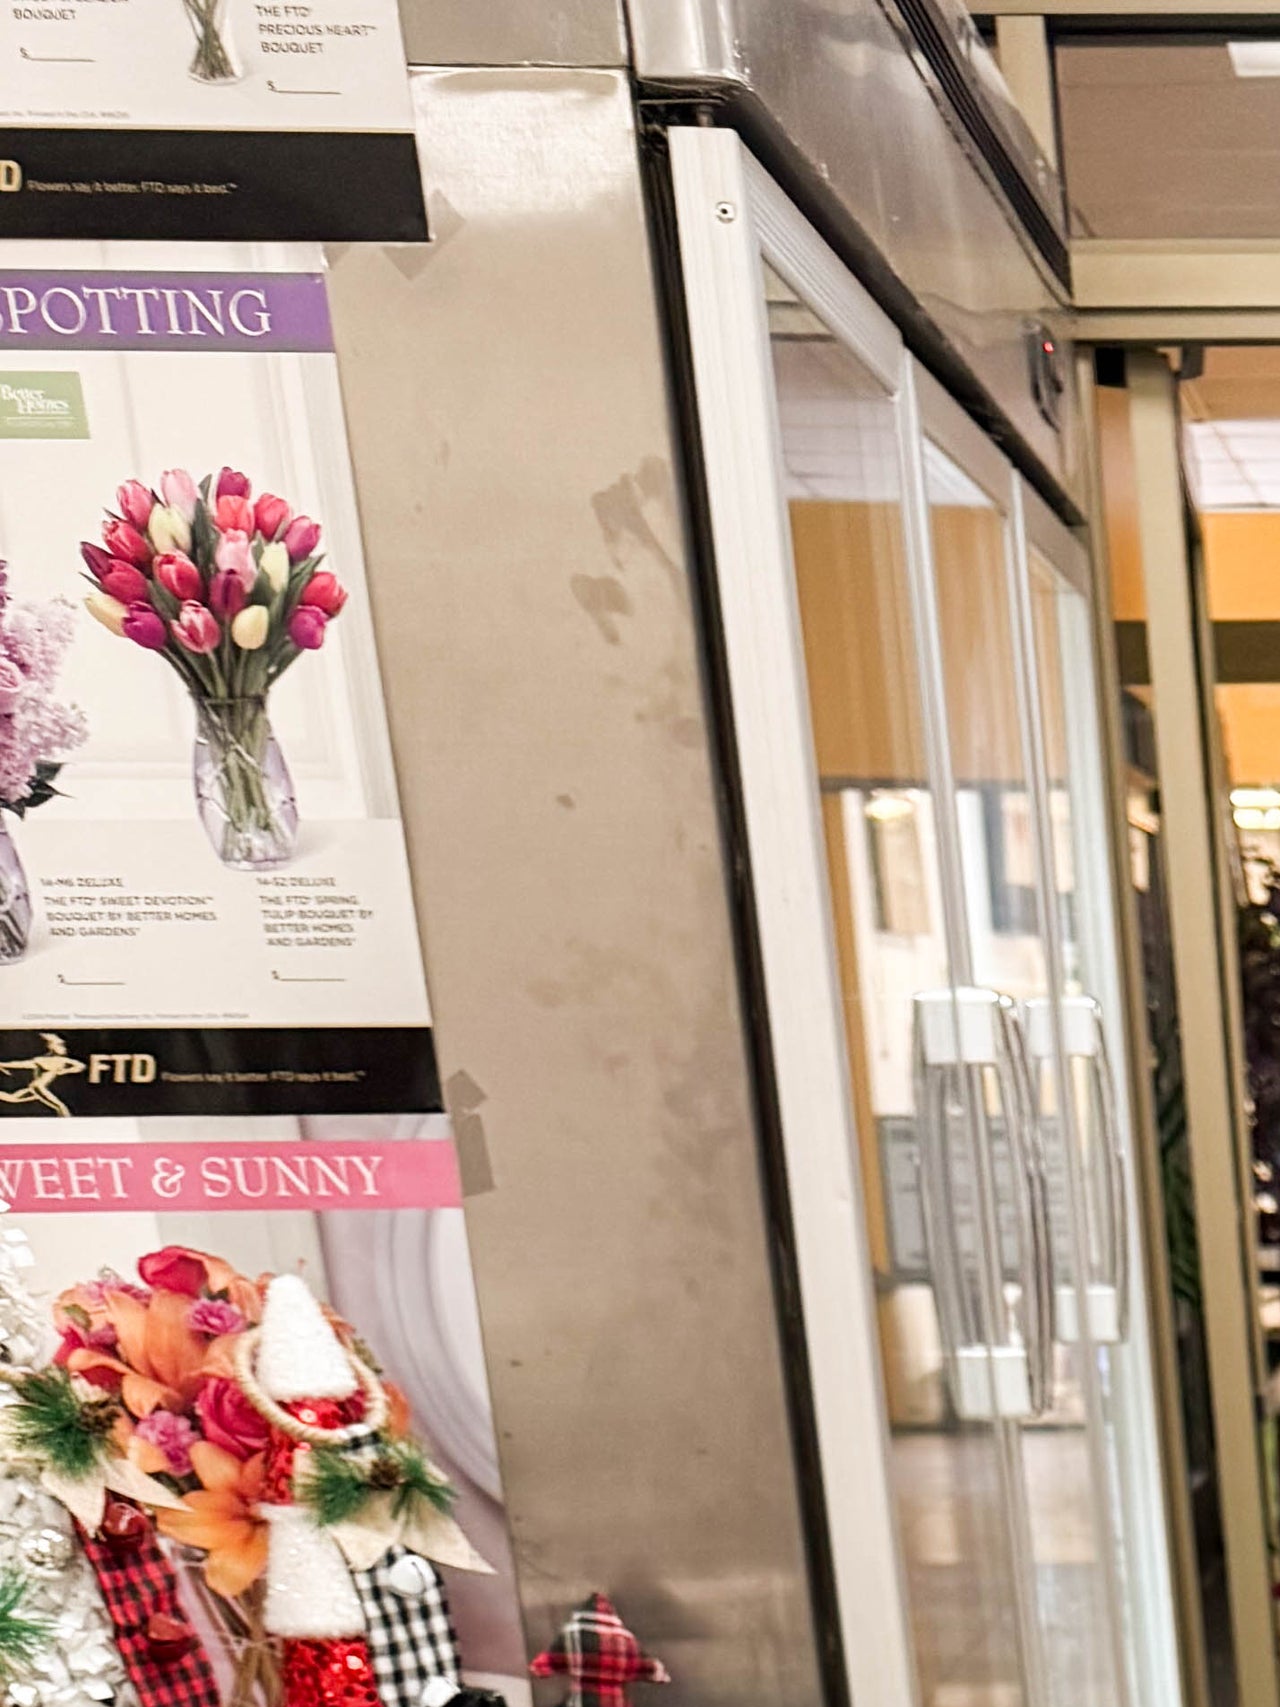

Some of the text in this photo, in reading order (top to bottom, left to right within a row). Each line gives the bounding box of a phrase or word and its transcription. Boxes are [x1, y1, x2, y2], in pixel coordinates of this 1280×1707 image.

[13, 8, 76, 20] BOUQUET
[255, 5, 280, 17] THE
[258, 24, 322, 35] PRECIOUS
[260, 42, 323, 53] BOUQUET
[0, 287, 272, 336] POTTING
[88, 1054, 156, 1084] FTD
[152, 1157, 186, 1198] &
[201, 1156, 383, 1198] SUNNY
